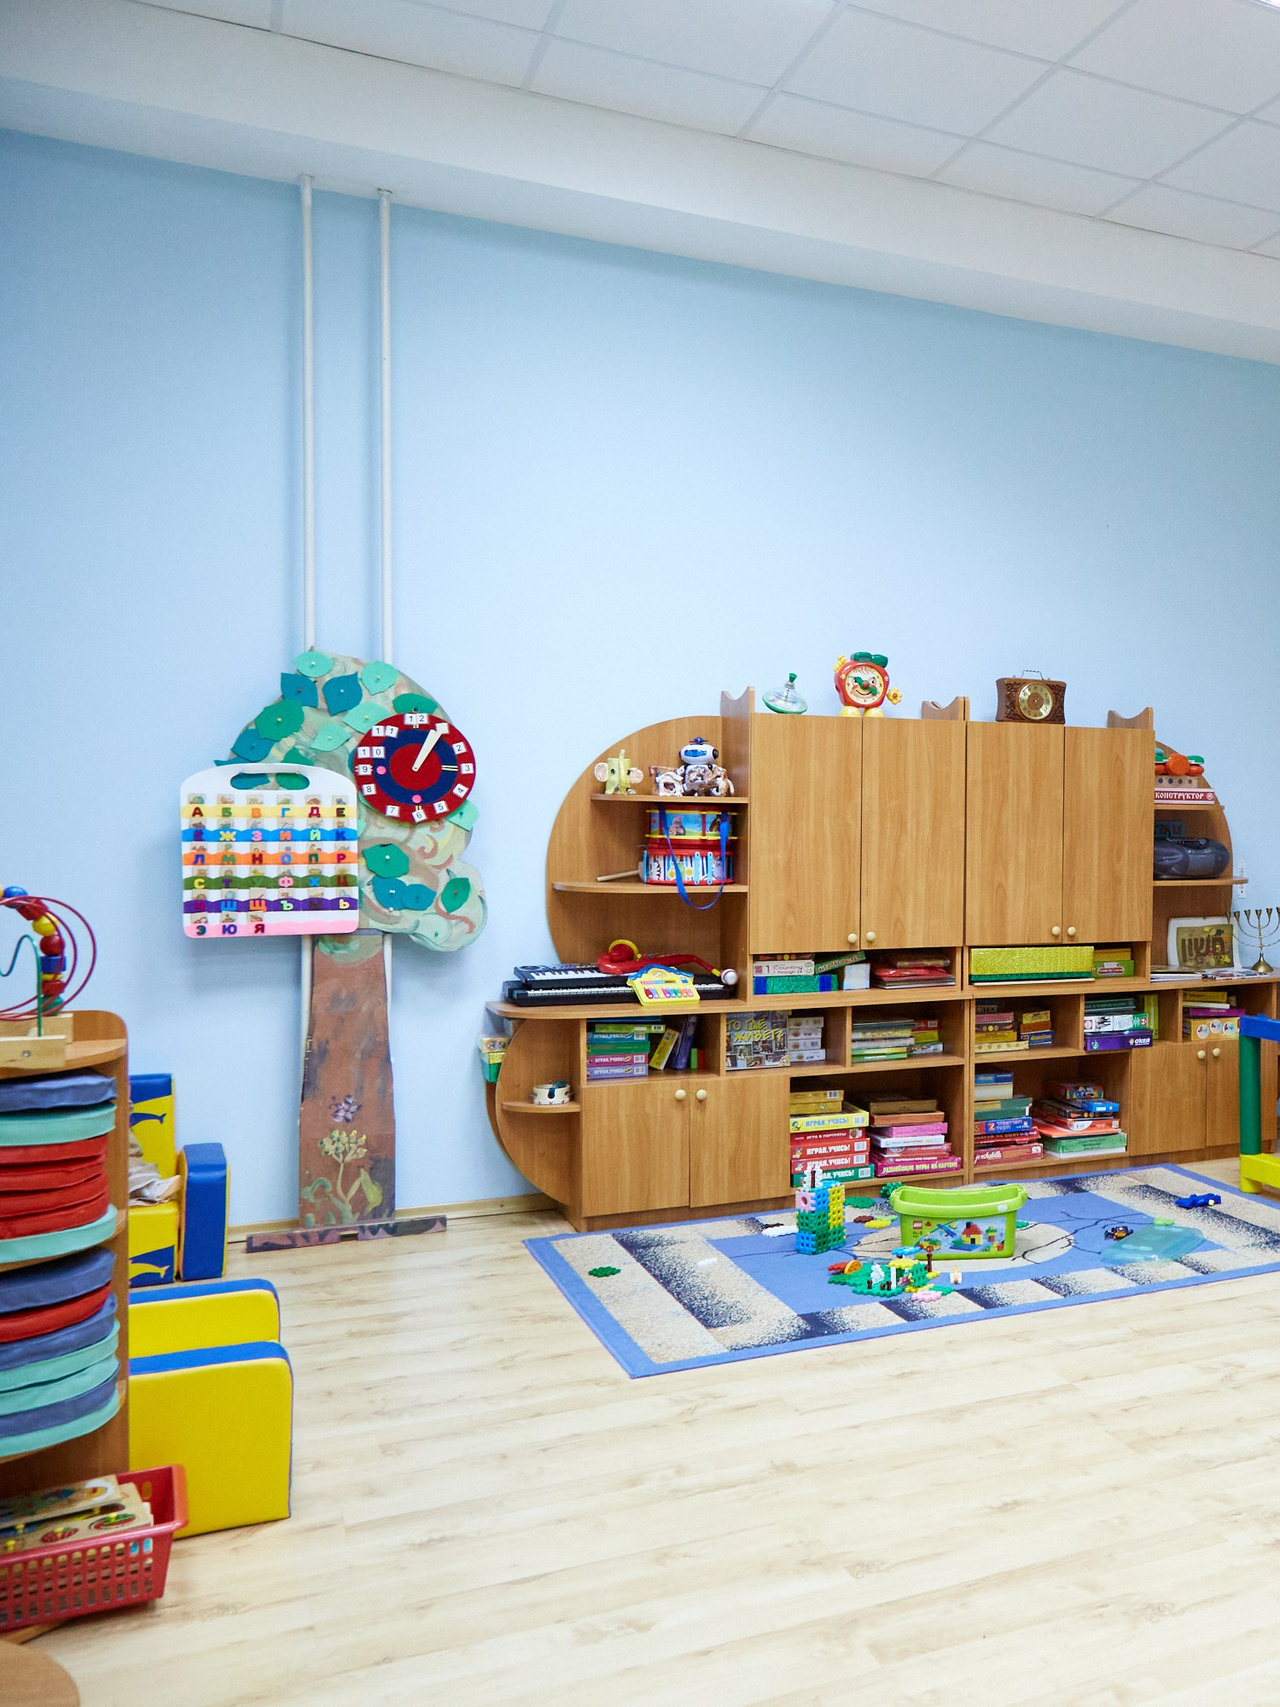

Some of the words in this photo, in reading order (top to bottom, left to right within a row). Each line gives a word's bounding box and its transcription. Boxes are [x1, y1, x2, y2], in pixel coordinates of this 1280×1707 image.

[1155, 792, 1204, 800] КОНСТРУКТОР
[192, 807, 203, 817] А
[222, 807, 232, 817] Б
[251, 807, 262, 818] В
[281, 807, 290, 817] Г
[308, 806, 321, 818] Д
[336, 807, 346, 817] Е
[219, 830, 236, 842] Ж
[251, 830, 262, 841] З
[279, 830, 291, 841] И
[309, 829, 321, 841] Й
[335, 830, 347, 841] К
[192, 853, 205, 865] Л
[221, 854, 237, 864] М
[252, 853, 263, 864] Н
[281, 853, 292, 864] О
[308, 853, 319, 863] П
[337, 853, 347, 864] Р
[194, 878, 205, 889] С
[221, 878, 232, 889] Т
[278, 876, 294, 888] Ф
[308, 876, 320, 887] Х
[336, 876, 348, 887] Ц
[194, 901, 205, 911] Ч
[220, 900, 237, 911] Ш
[249, 900, 267, 912] Щ
[280, 900, 294, 911] Ъ
[339, 899, 349, 910] Ь
[196, 925, 207, 935] Э
[222, 923, 237, 935] Ю
[254, 923, 265, 934] Я
[726, 1019, 741, 1031] ТО
[829, 1144, 851, 1153] УЧИСЬ!
[829, 1157, 851, 1166] УЧИСЬ!
[833, 1169, 855, 1178] УЧИСЬ!
